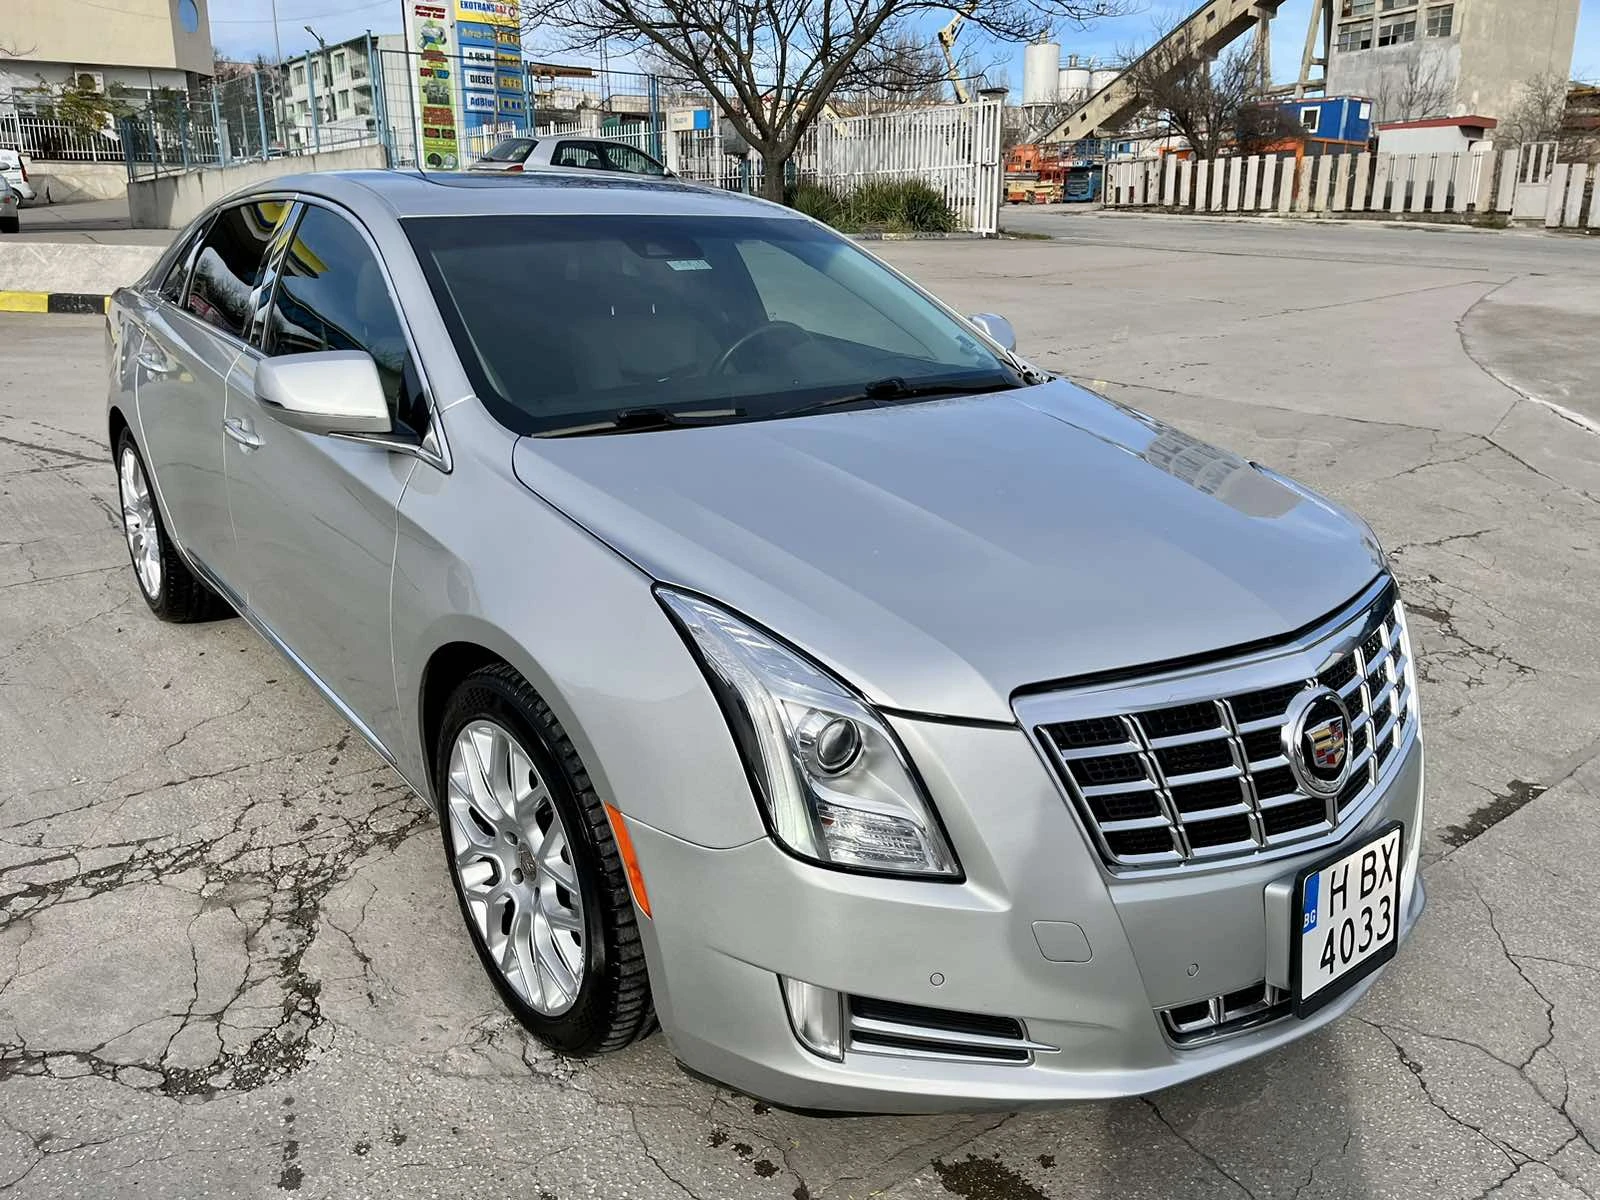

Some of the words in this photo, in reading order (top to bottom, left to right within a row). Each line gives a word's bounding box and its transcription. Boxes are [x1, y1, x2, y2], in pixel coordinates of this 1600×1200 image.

[469, 74, 494, 85] DIESEL
[1329, 863, 1350, 918] H
[1359, 837, 1396, 901] BX
[1303, 909, 1317, 929] BG
[1319, 894, 1391, 975] 4033
